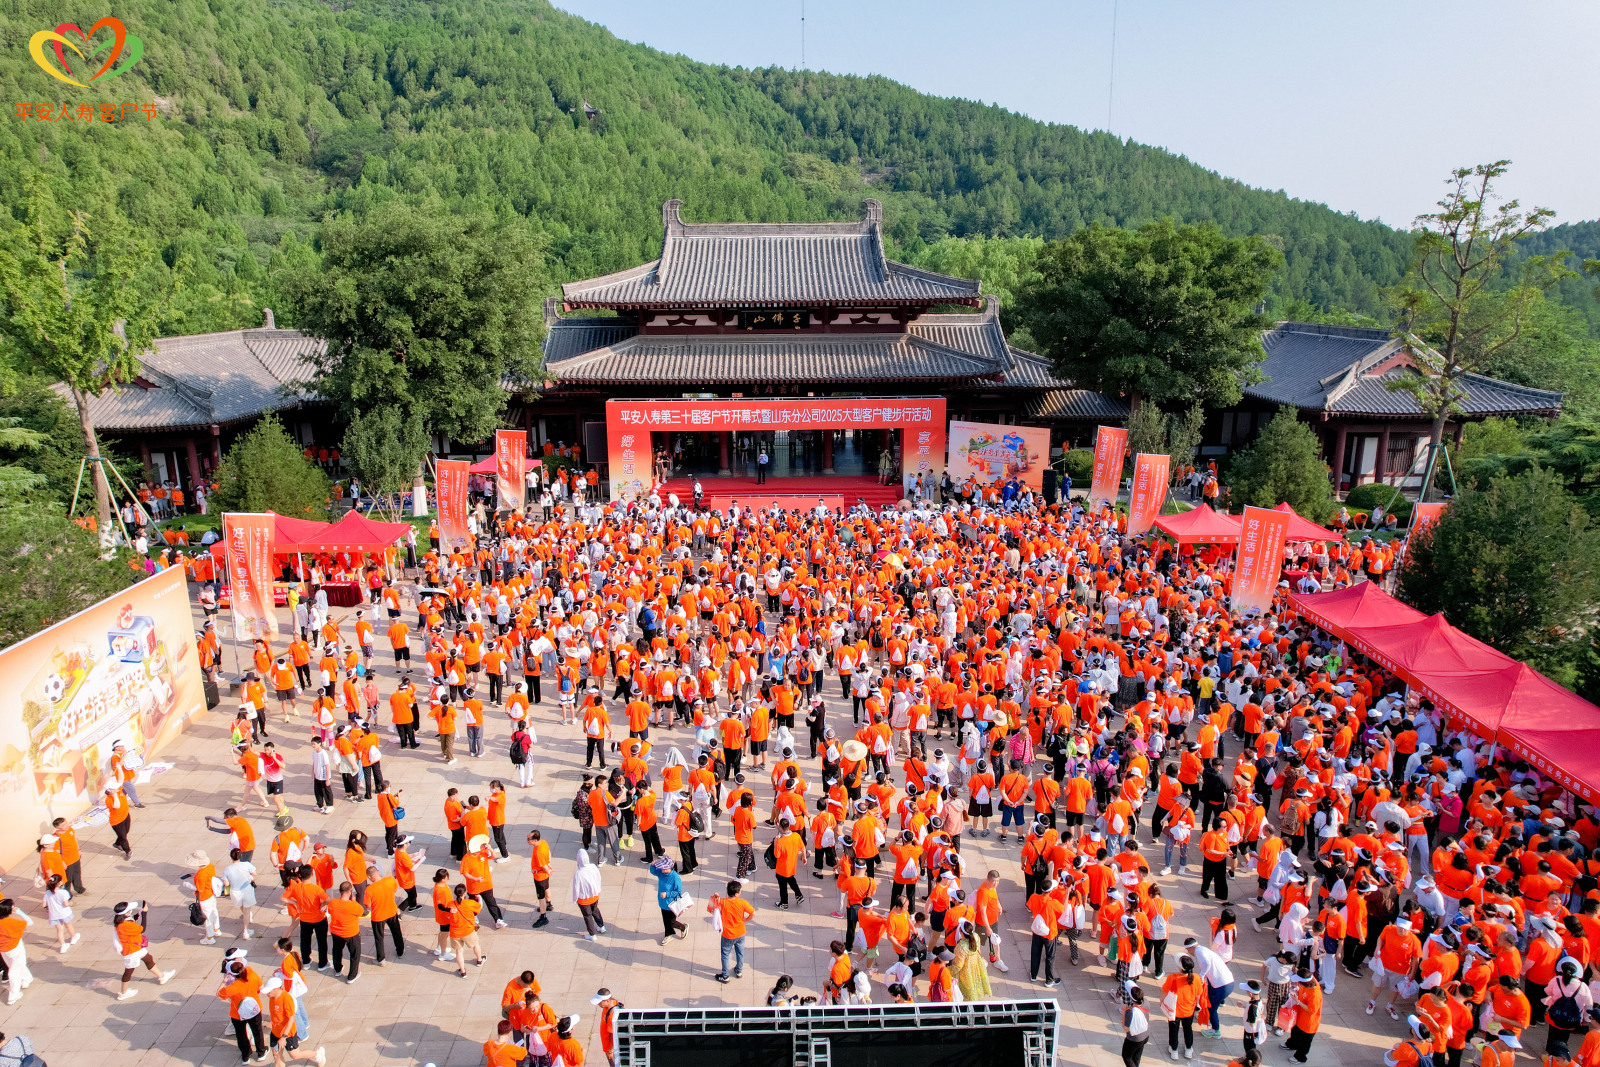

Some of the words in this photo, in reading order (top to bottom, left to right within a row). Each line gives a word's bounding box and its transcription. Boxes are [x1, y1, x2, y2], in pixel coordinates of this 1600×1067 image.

[620, 407, 932, 425] 平安人寿第三十届客户节开幕式暨山东分公司2025大型客户健步行活动
[500, 437, 508, 462] 好生活
[621, 434, 635, 475] 好生活
[917, 431, 932, 471] 享平安
[1098, 435, 1109, 461] 好生活
[440, 469, 449, 497] 好生活
[1138, 463, 1150, 491] 好生活
[232, 527, 245, 564] 好生活
[1244, 519, 1260, 553] 好生活
[236, 567, 251, 602] 享平安
[1239, 556, 1255, 590] 享平安
[1513, 742, 1591, 798] 济南第四业务发展部
